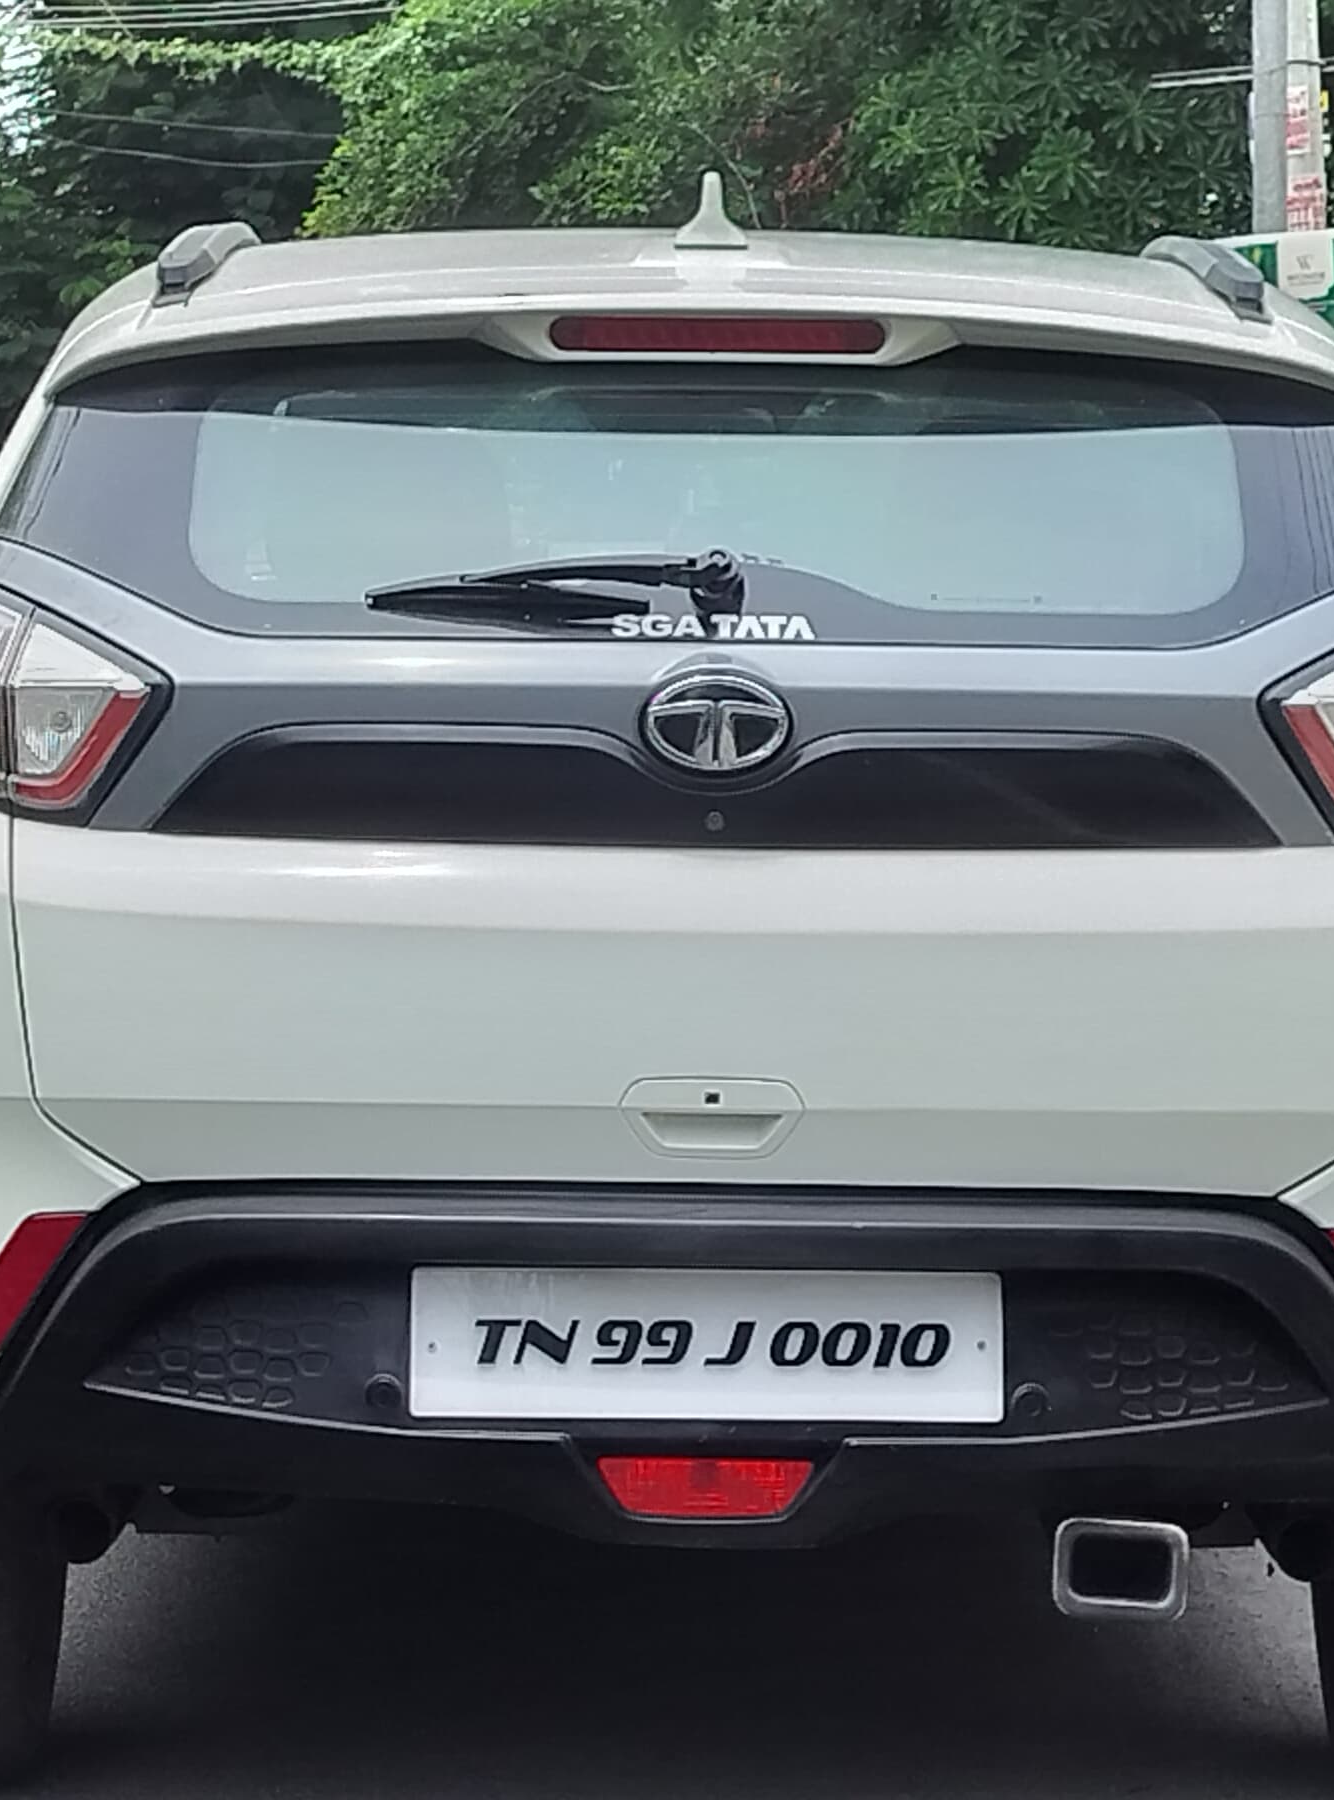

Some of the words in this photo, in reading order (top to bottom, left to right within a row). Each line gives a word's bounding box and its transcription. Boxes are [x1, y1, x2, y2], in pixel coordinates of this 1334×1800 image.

[611, 614, 706, 638] SGA
[711, 614, 815, 640] TATA
[474, 1319, 581, 1366] TN
[591, 1319, 693, 1366] 99
[703, 1321, 757, 1367] J
[769, 1321, 951, 1369] 0010
